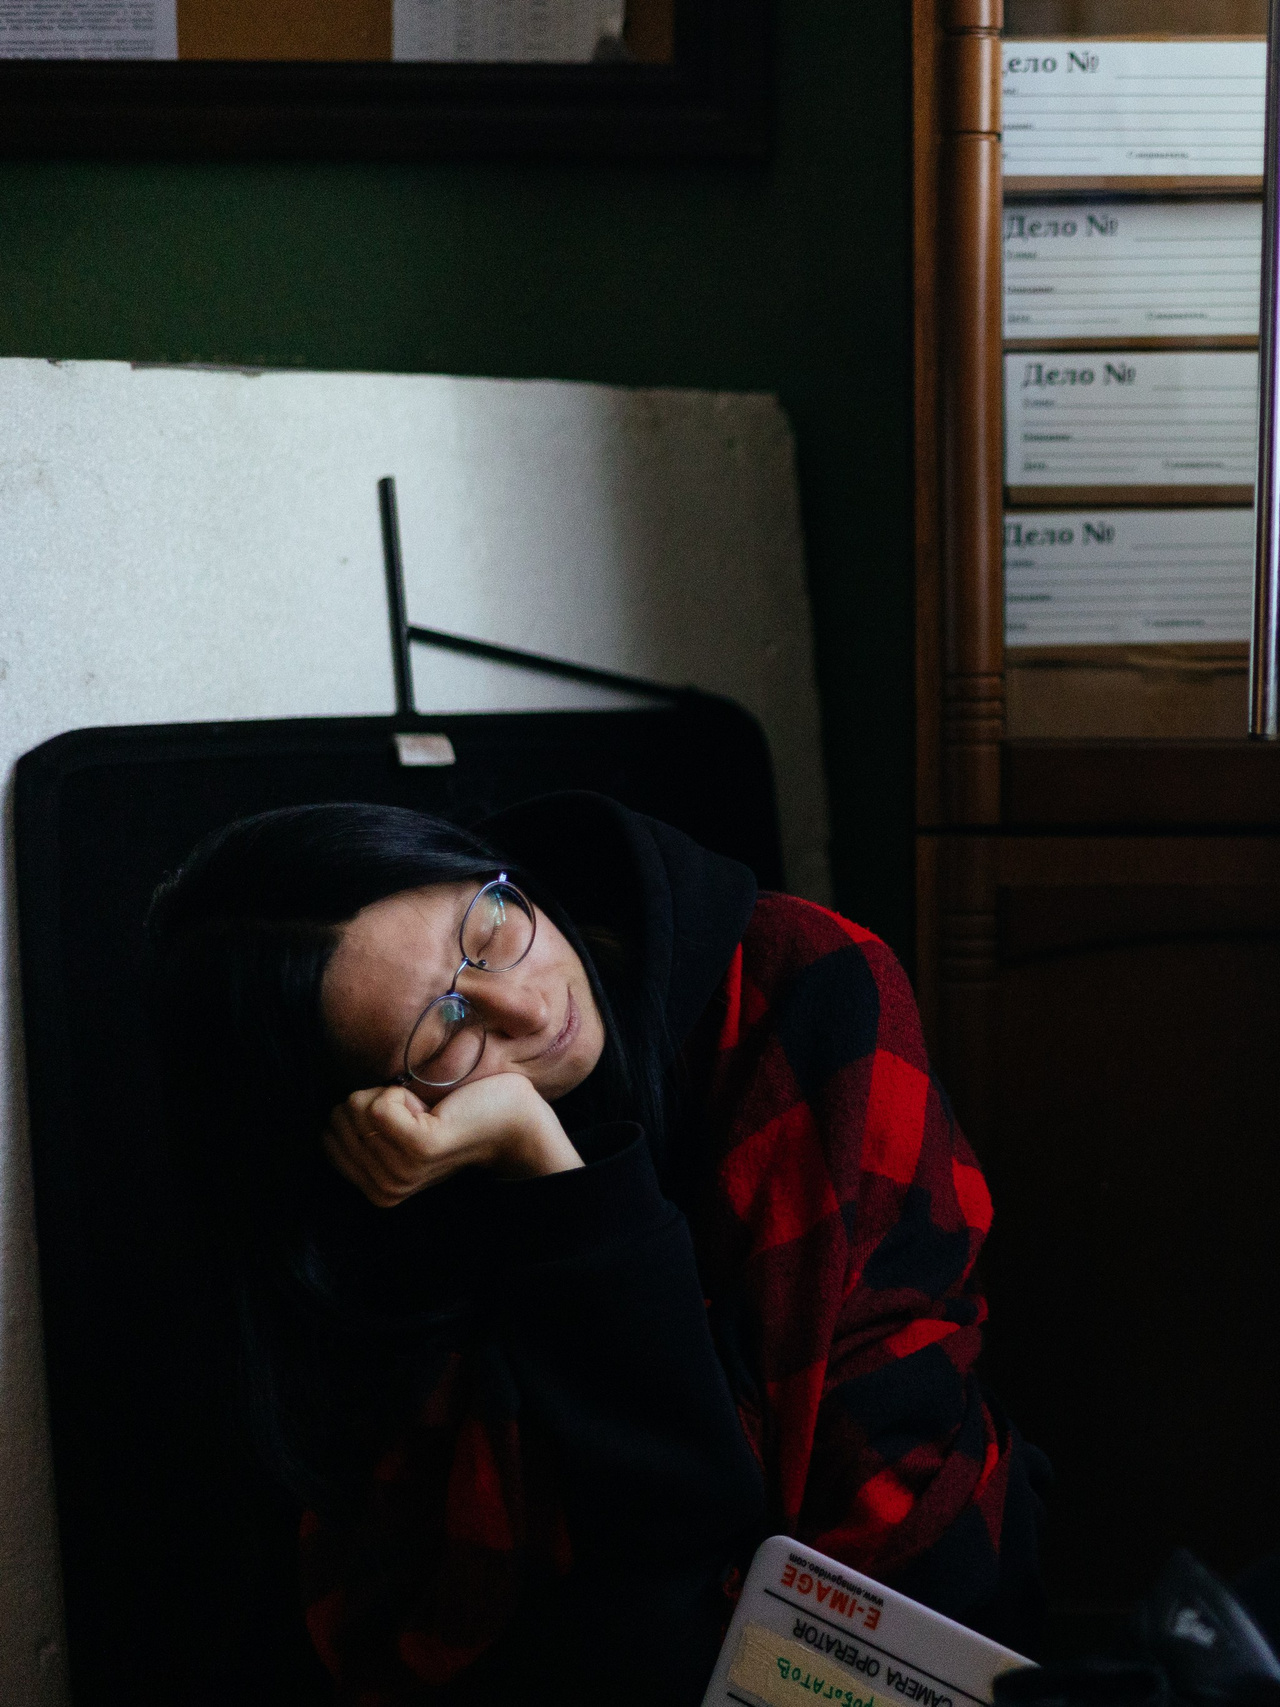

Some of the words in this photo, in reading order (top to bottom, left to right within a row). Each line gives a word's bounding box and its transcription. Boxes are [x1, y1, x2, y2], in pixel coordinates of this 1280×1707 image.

[1002, 56, 1057, 75] ело
[1067, 51, 1099, 73] №
[1007, 215, 1078, 240] Дело
[1087, 214, 1119, 237] №
[1022, 362, 1095, 387] Дело
[1102, 362, 1136, 386] №
[1082, 521, 1116, 545] №
[789, 1553, 884, 1607] www.eimagevideo.com
[781, 1564, 881, 1631] E-IMAGE
[793, 1618, 880, 1677] OPERATOR
